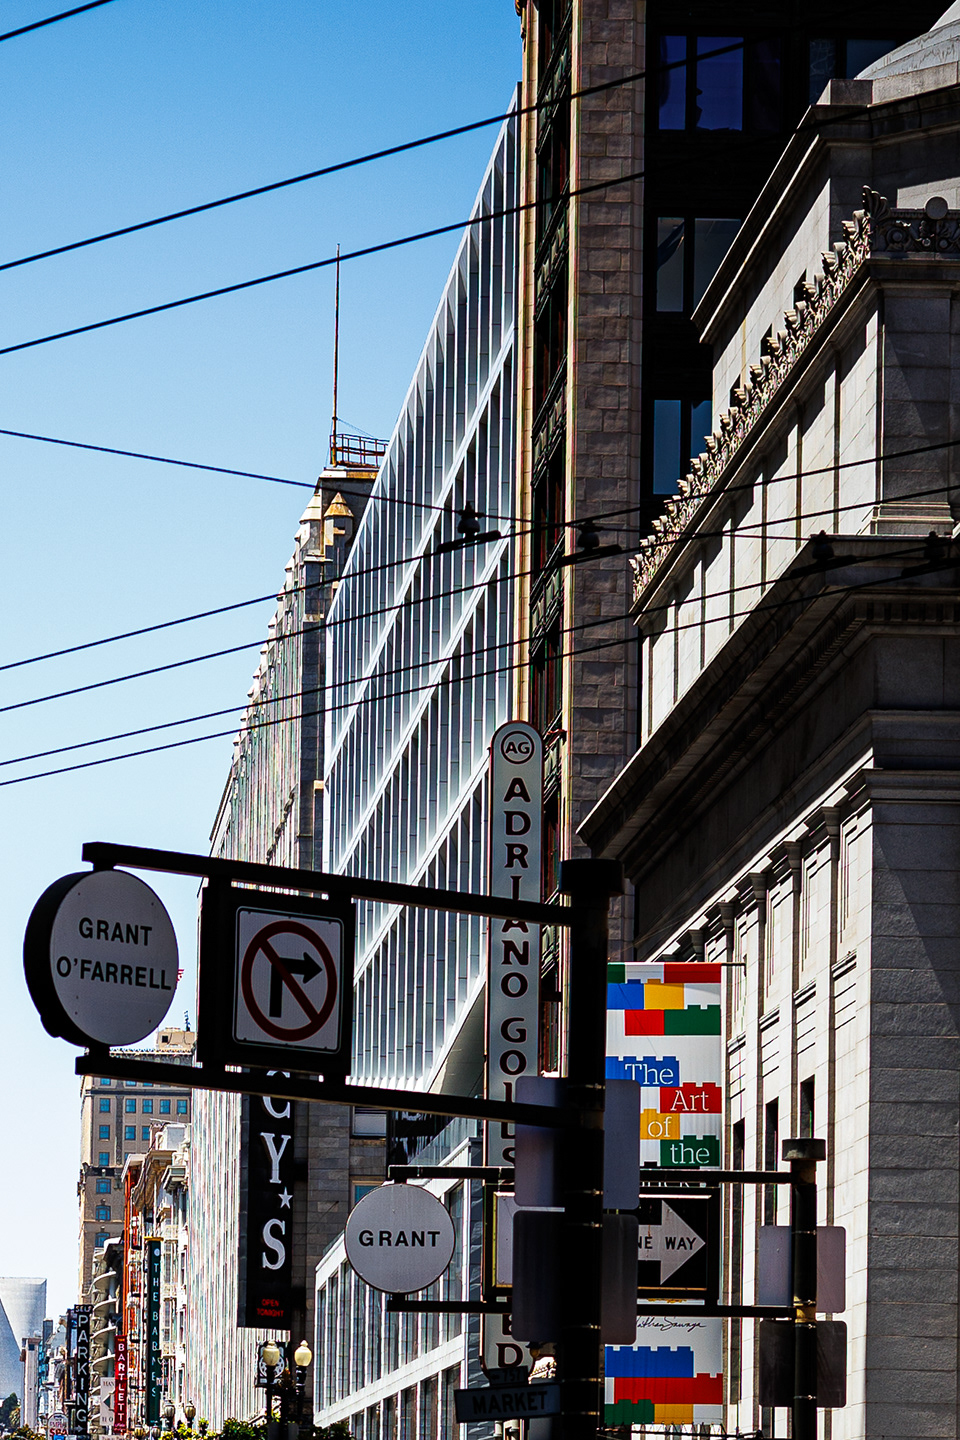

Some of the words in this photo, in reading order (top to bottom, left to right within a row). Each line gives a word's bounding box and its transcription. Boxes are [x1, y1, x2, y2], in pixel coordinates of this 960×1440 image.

[506, 742, 530, 754] AG
[79, 917, 152, 946] GRANT
[56, 956, 171, 990] O'FARRELL
[625, 1064, 673, 1085] The
[670, 1090, 709, 1111] Art
[647, 1117, 672, 1137] of
[670, 1143, 710, 1164] the
[359, 1230, 440, 1247] GRANT
[665, 1236, 697, 1250] WAY
[77, 1314, 89, 1422] PARKING
[503, 1369, 520, 1381] 757
[117, 1342, 126, 1421] BARTLETT
[472, 1390, 548, 1415] MARKET
